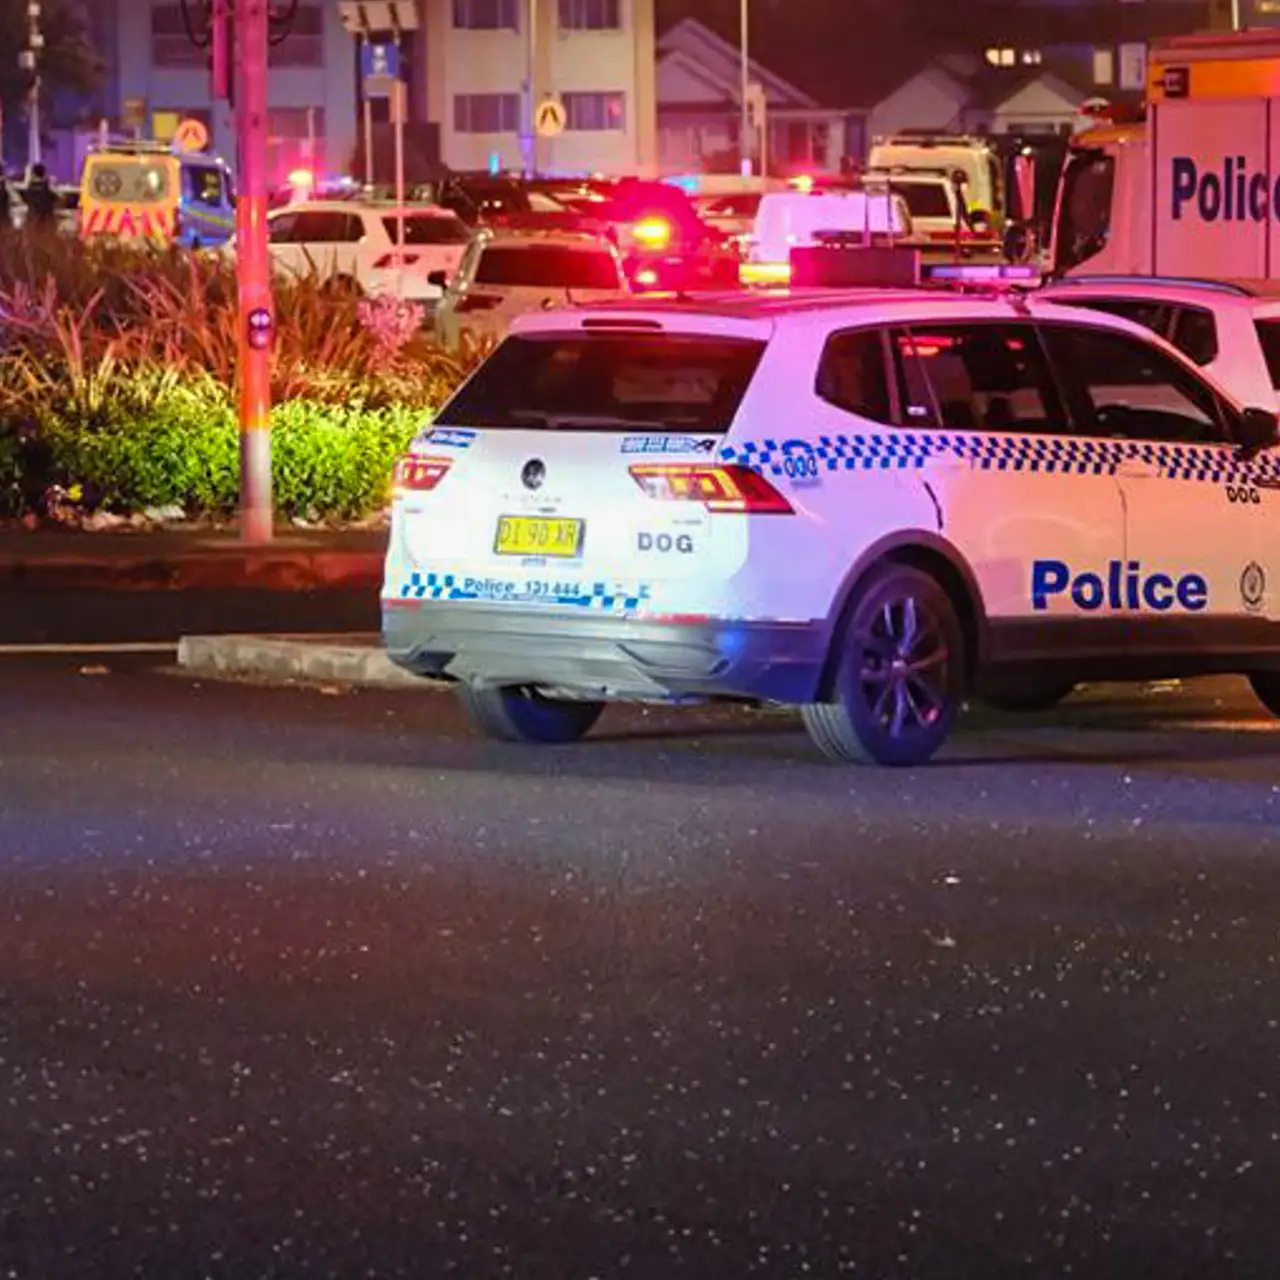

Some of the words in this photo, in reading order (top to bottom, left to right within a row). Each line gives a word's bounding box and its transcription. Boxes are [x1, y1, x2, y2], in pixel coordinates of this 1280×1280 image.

[1226, 486, 1261, 504] DOG
[637, 531, 694, 554] DOG
[463, 576, 516, 594] Police
[1032, 559, 1208, 610] Police
